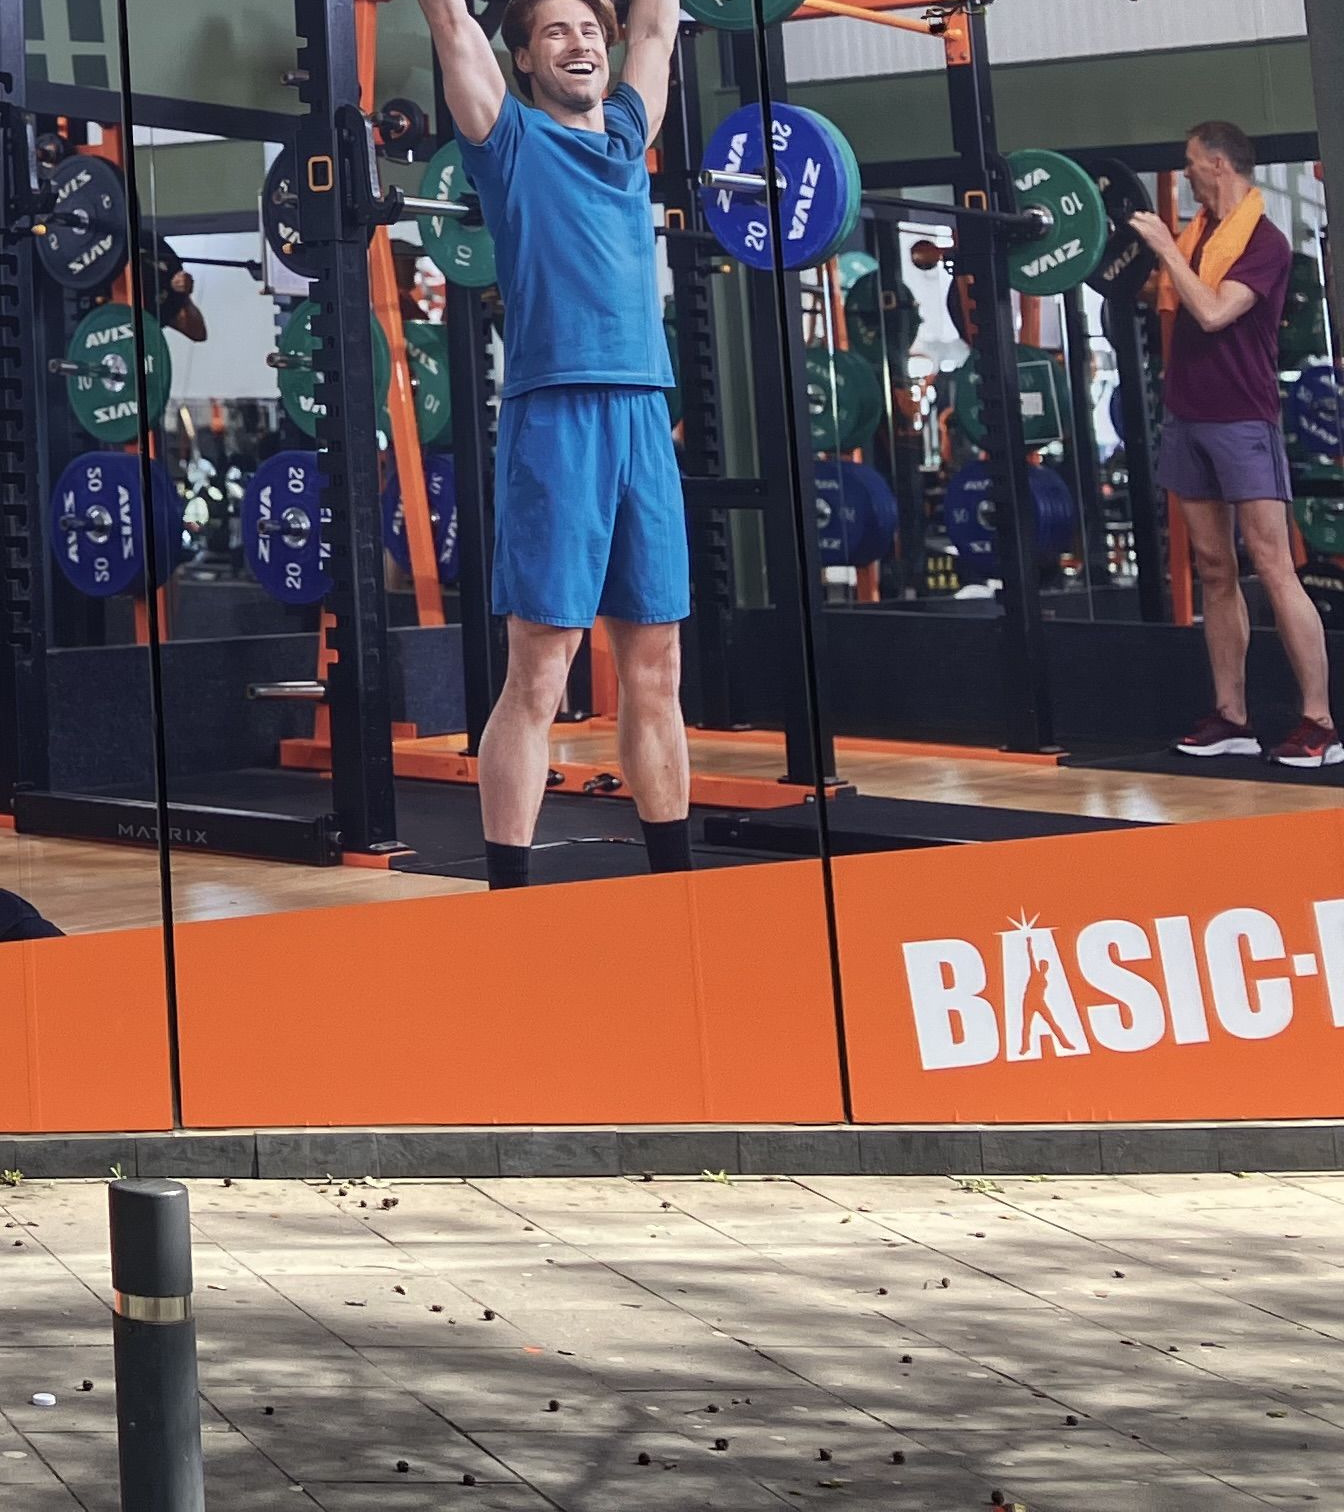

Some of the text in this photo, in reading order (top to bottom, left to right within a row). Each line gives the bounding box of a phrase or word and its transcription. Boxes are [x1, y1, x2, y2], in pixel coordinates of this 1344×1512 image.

[771, 119, 793, 152] 20
[715, 132, 749, 214] ZVA
[787, 157, 822, 241] ZIVA
[1059, 191, 1085, 216] 10
[744, 220, 768, 252] 20
[454, 244, 473, 267] 10
[1019, 237, 1085, 278] ZIVA
[287, 466, 305, 494] 20
[284, 561, 302, 590] 20
